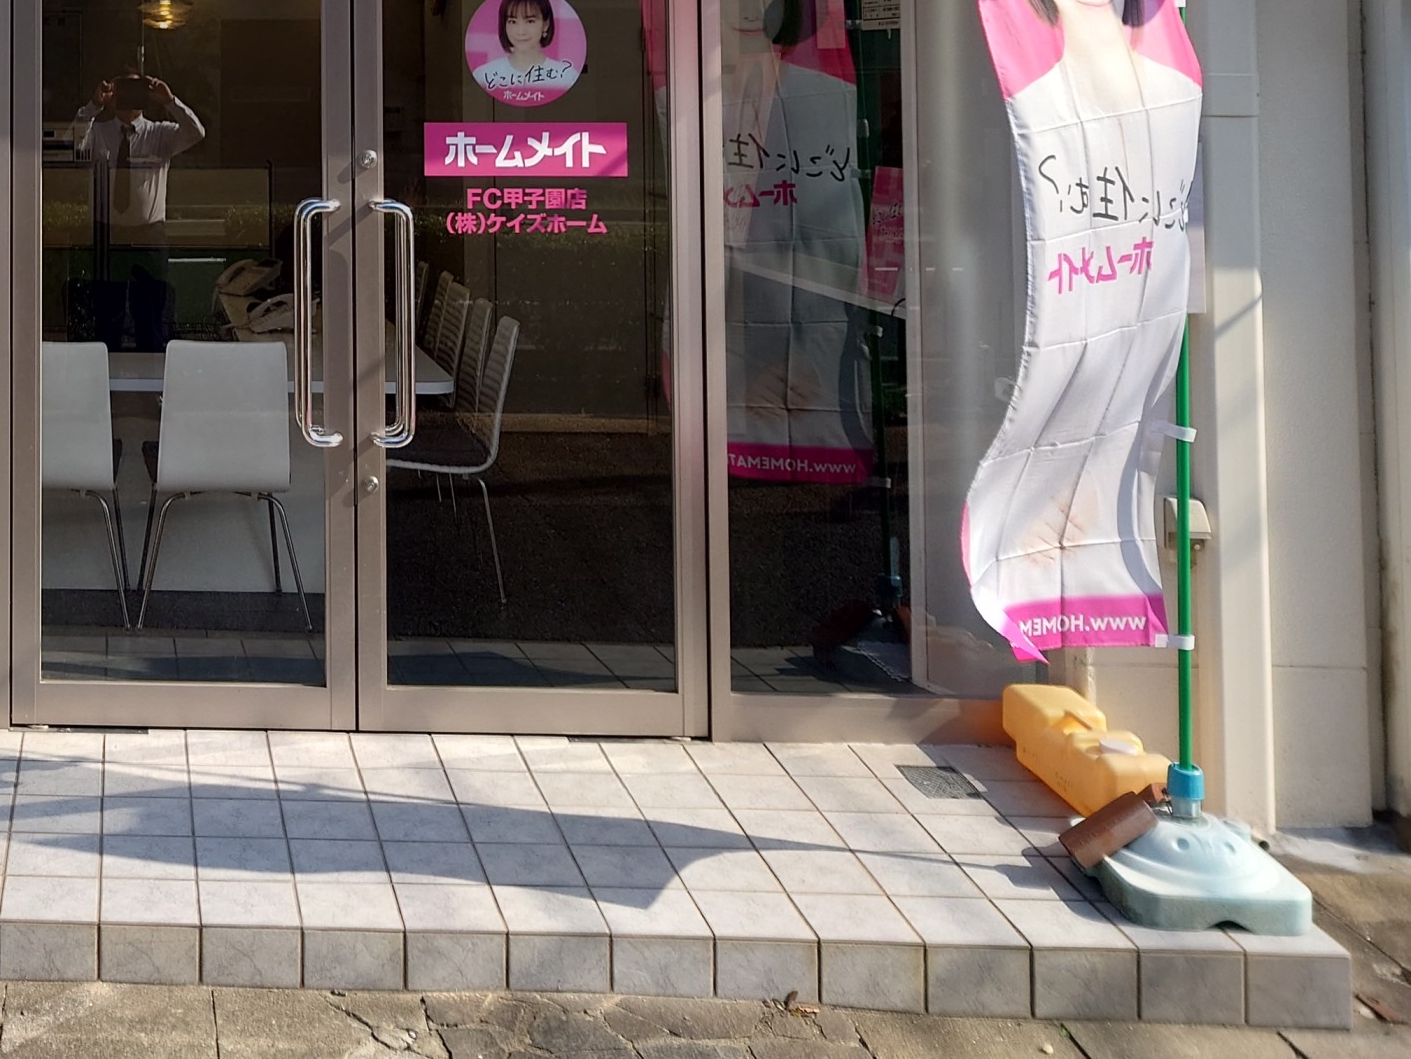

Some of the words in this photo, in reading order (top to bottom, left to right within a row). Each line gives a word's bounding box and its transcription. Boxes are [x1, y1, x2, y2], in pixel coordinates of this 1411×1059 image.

[503, 90, 545, 102] ホームメイト
[445, 131, 607, 168] ホームメイト
[466, 188, 588, 210] FC甲子園店
[446, 212, 608, 235] (株)ケイズホーム
